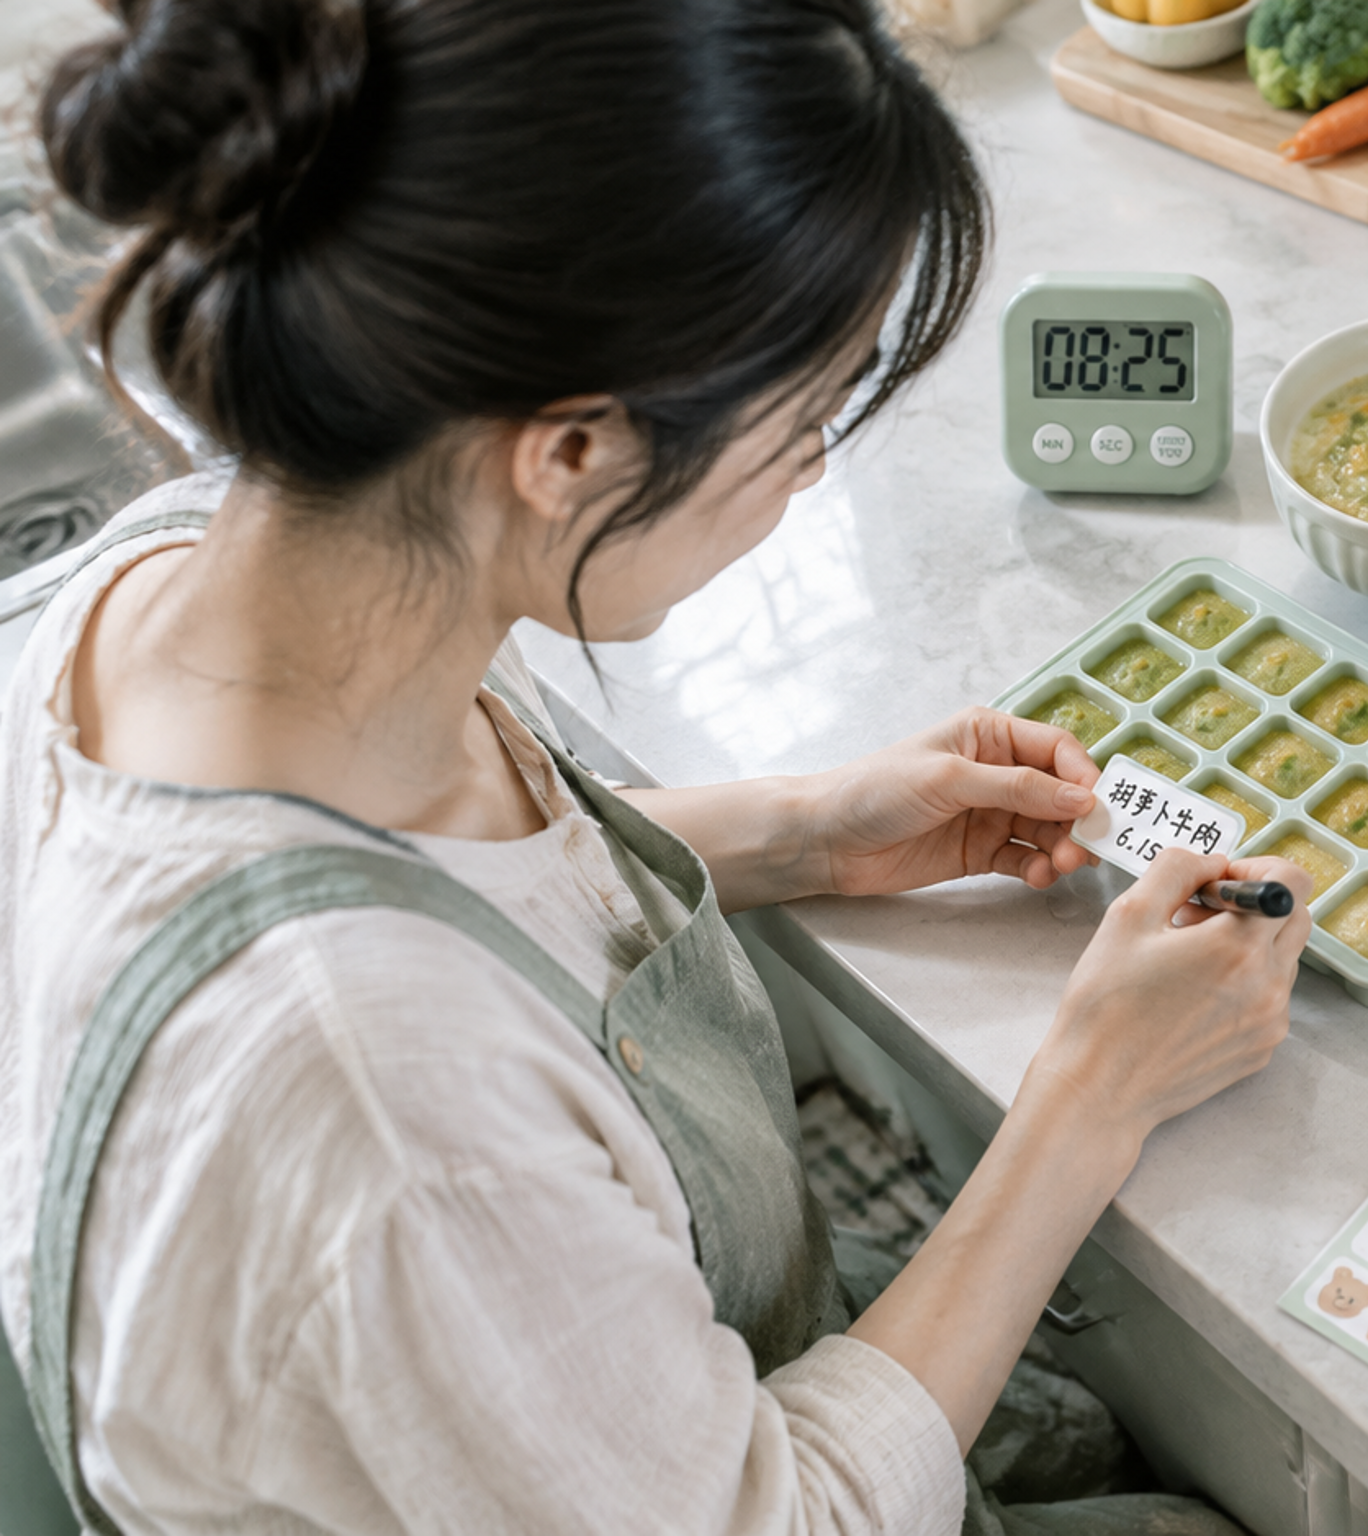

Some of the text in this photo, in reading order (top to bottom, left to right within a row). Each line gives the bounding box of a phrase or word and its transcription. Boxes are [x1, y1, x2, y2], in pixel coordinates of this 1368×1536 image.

[1042, 326, 1188, 395] 08:25
[1041, 438, 1064, 450] MIN
[1116, 827, 1163, 861] 6.15
